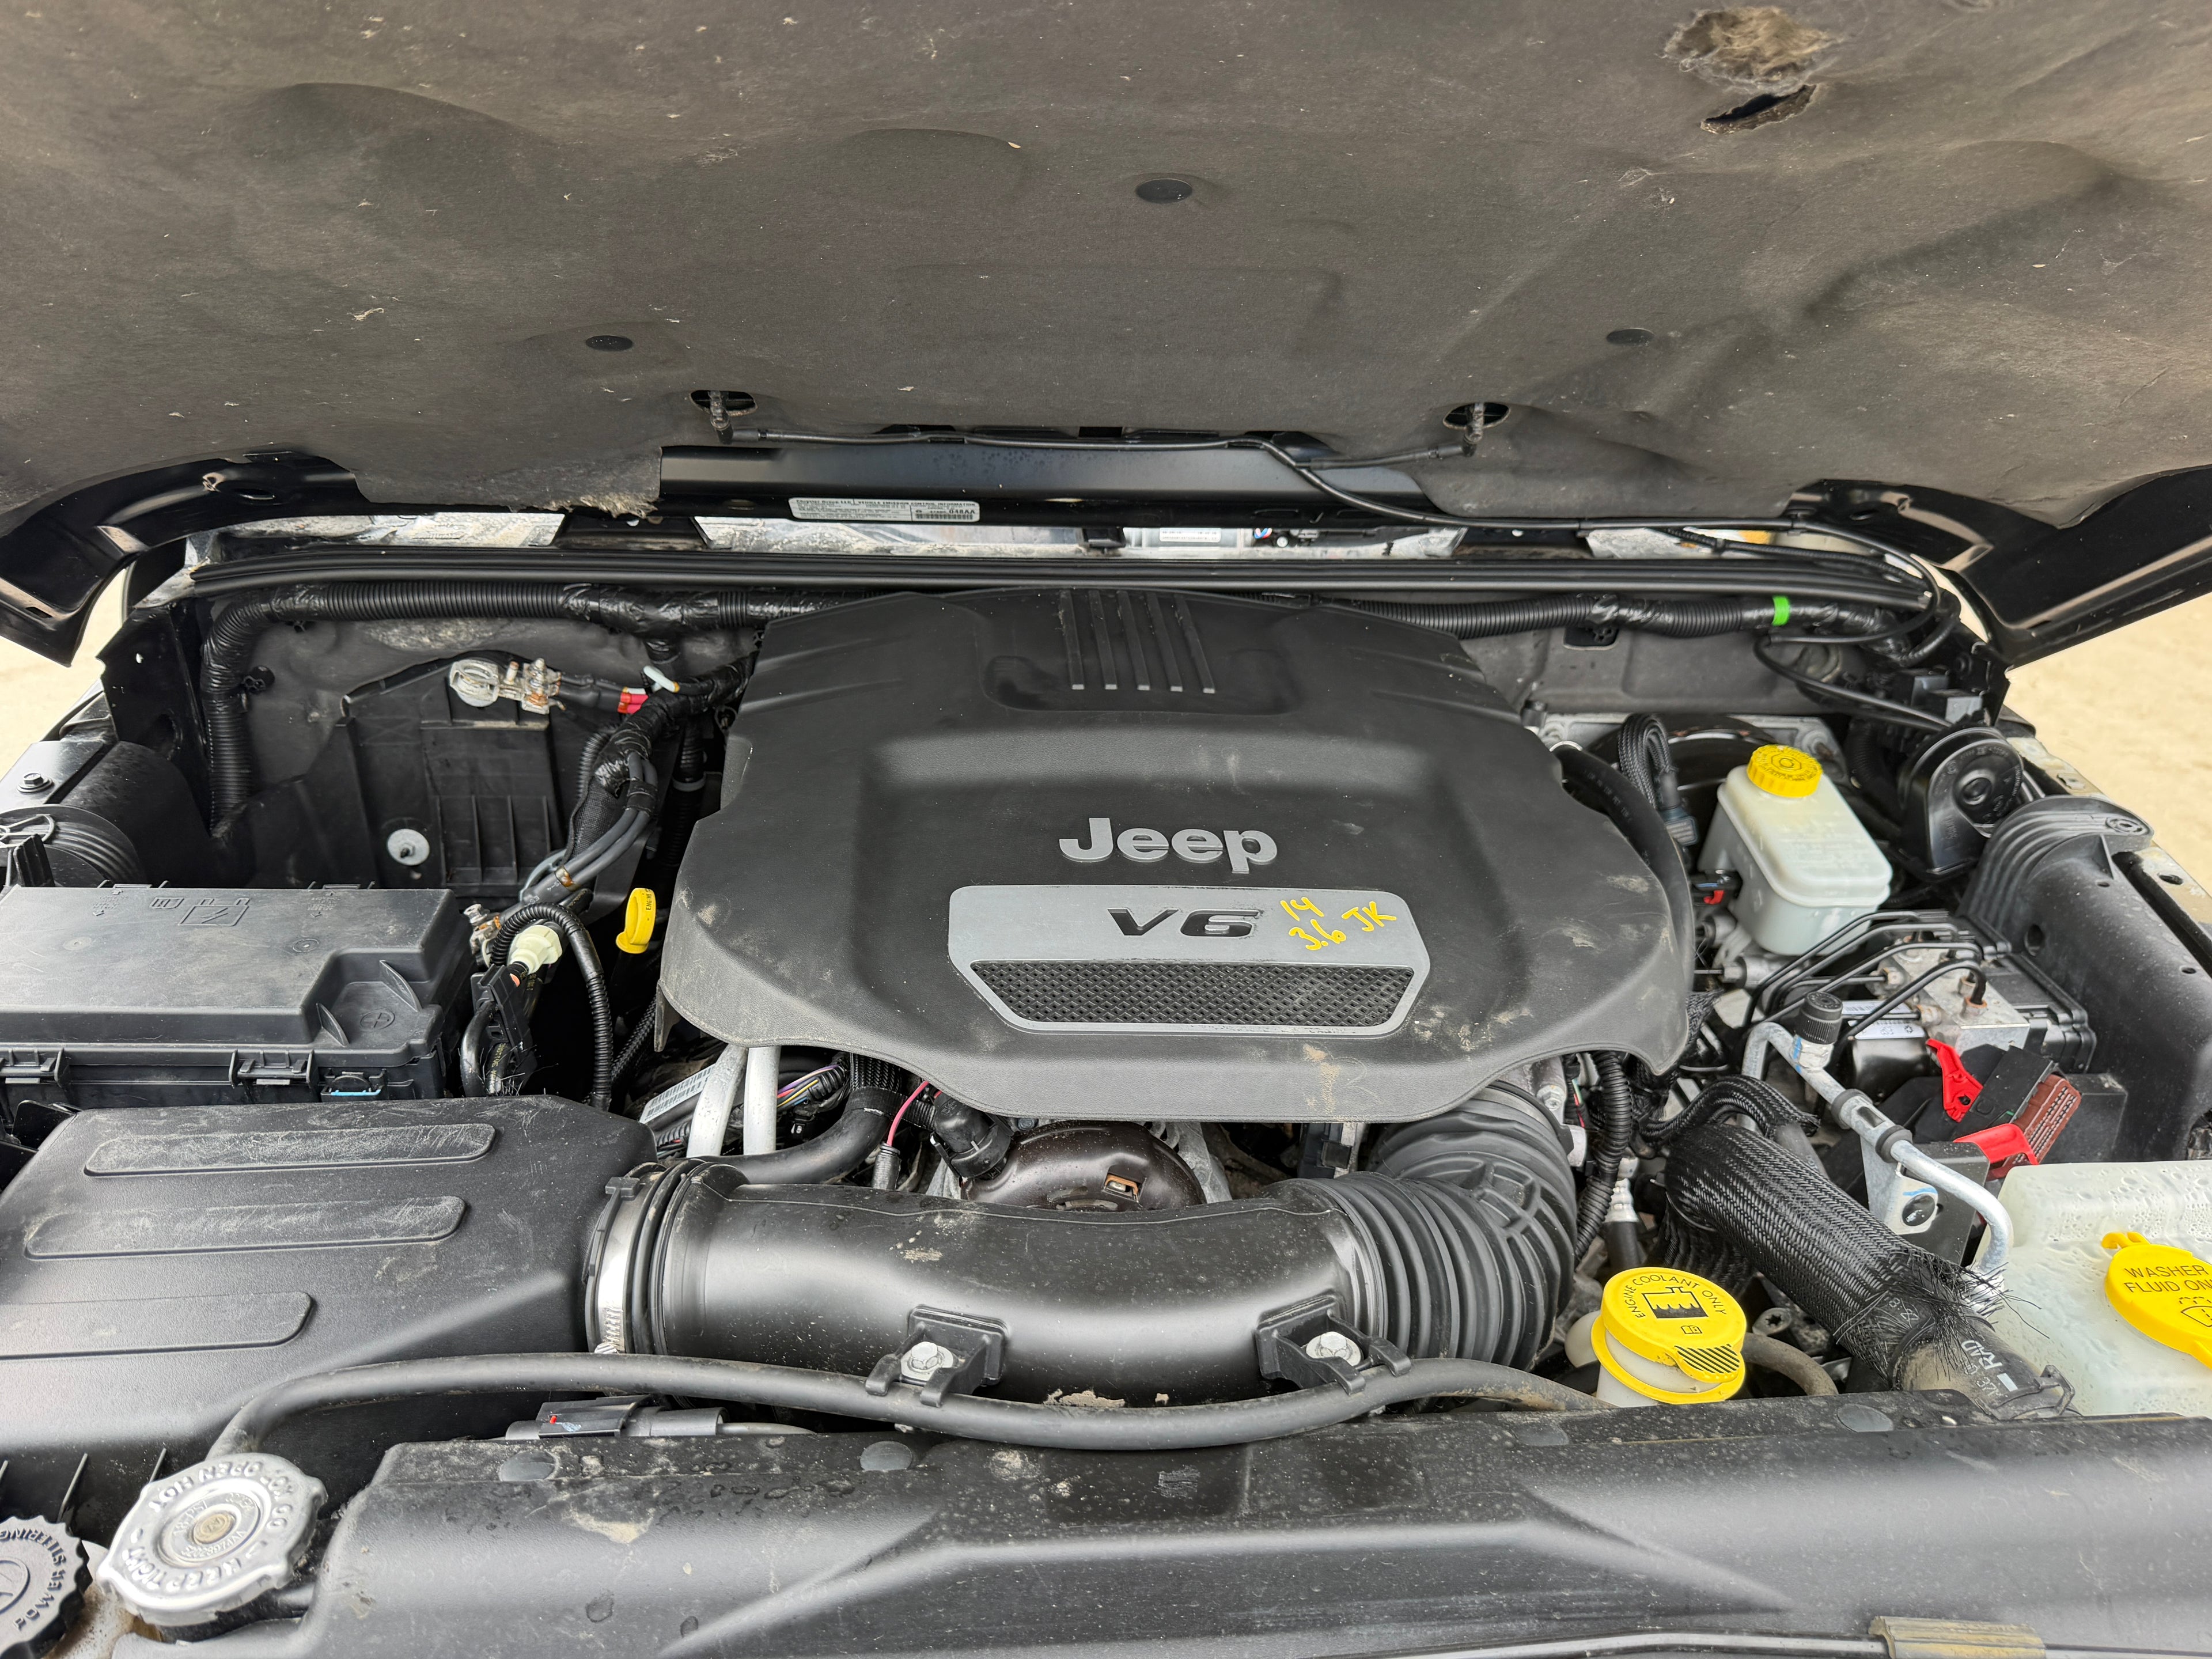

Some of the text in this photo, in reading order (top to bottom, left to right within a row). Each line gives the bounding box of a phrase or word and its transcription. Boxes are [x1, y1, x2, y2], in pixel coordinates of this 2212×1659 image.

[1059, 817, 1278, 874] Jeep
[1107, 907, 1265, 937] V6
[1289, 900, 1397, 951] 3.6 JK
[2123, 1264, 2210, 1279] WASHER
[2123, 1279, 2212, 1293] FLUID ON
[1624, 1274, 1728, 1319] ENGINE COOLANT ONLY
[1960, 1339, 2003, 1370] RAD
[198, 1460, 264, 1484] OPEN
[260, 1474, 294, 1500] NOT
[147, 1475, 194, 1513] HOT
[0, 1528, 67, 1632] POWER STEERING
[122, 1546, 241, 1593] KEEP TIGHT
